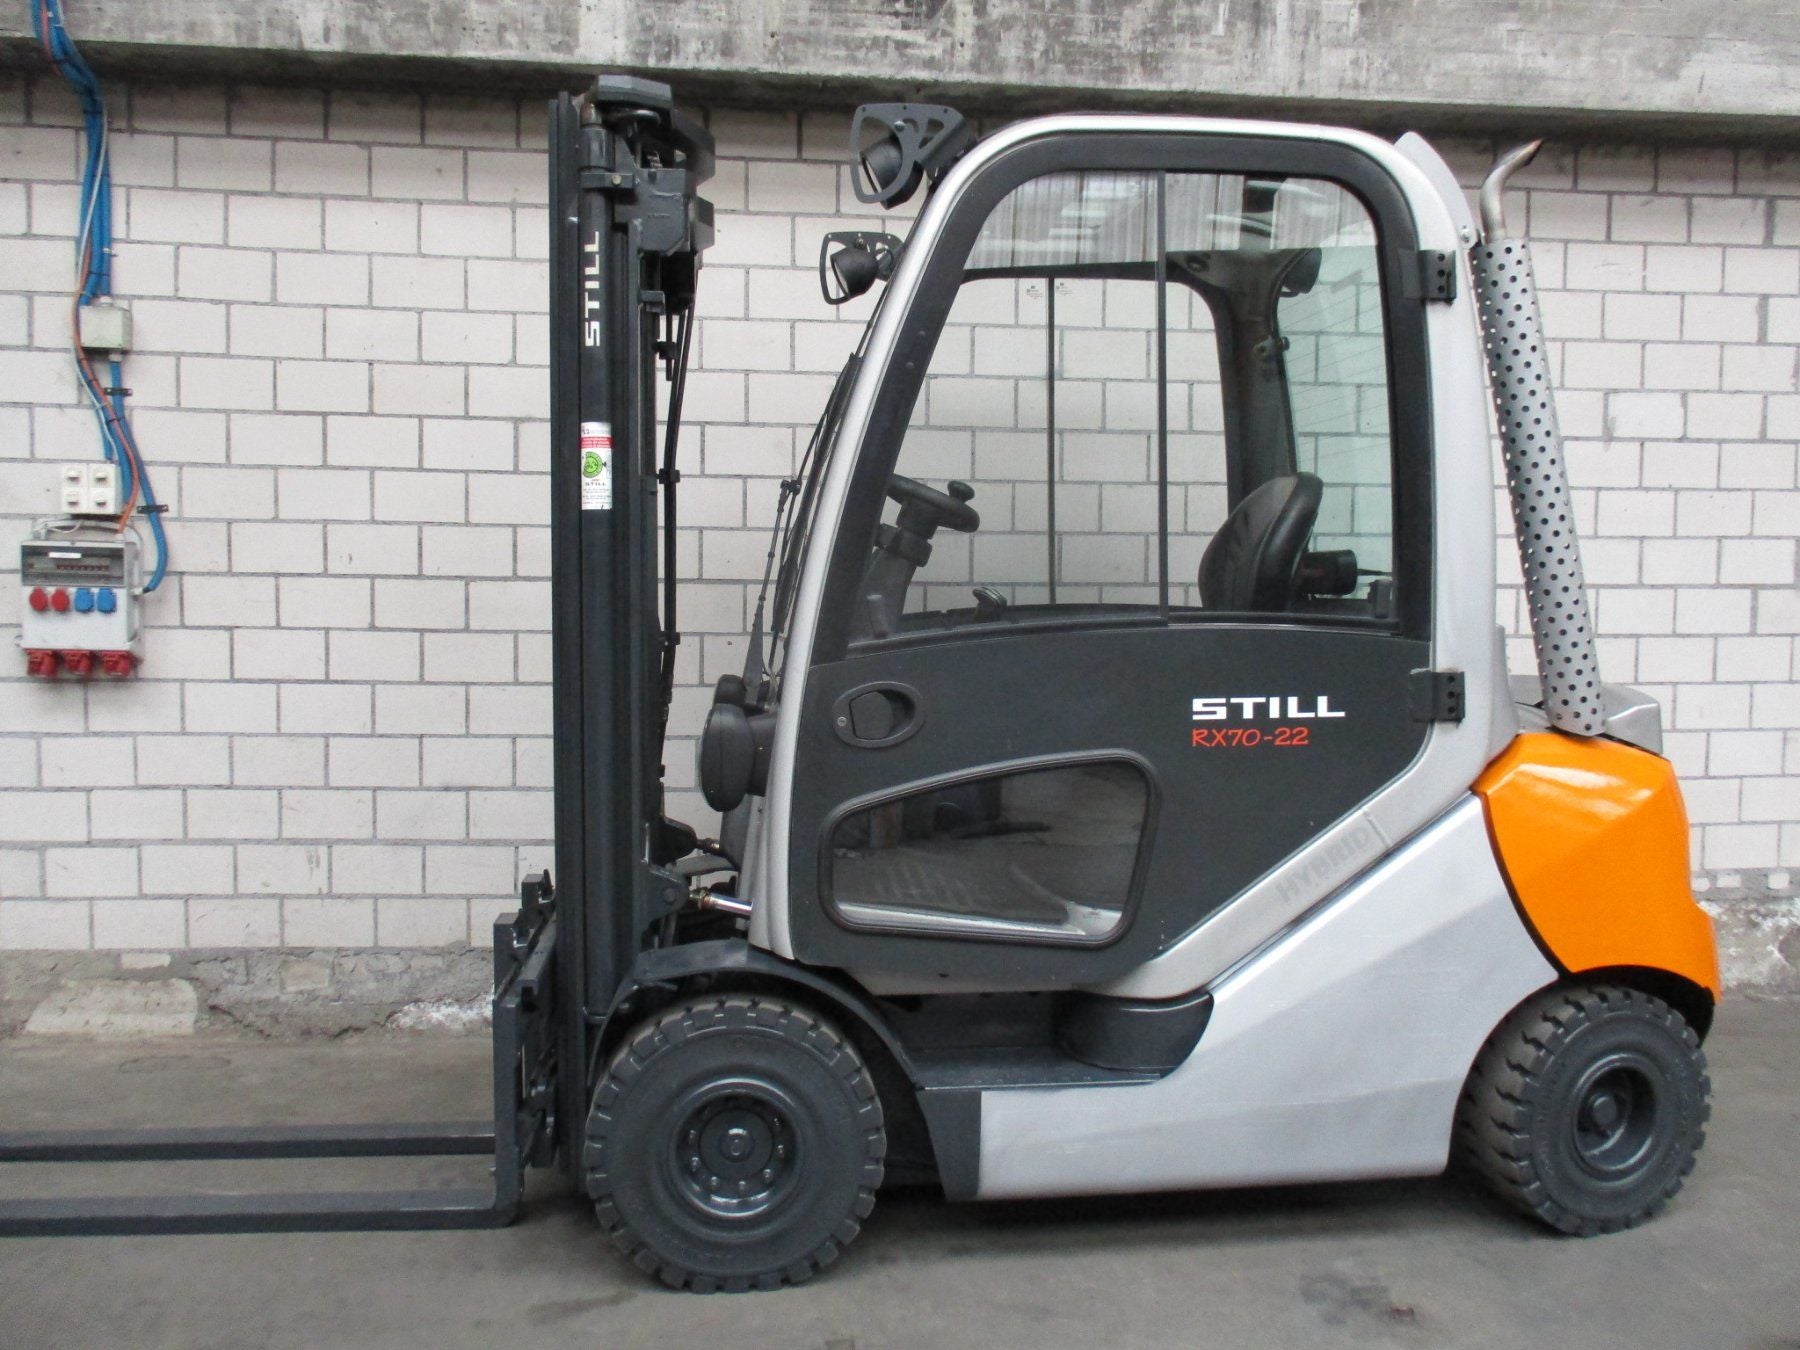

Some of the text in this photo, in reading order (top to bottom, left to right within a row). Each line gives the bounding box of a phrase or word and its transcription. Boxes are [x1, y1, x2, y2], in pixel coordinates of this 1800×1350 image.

[584, 231, 600, 347] STILL
[1192, 695, 1346, 721] STILL
[1191, 727, 1309, 747] RX70-22
[1275, 826, 1369, 903] HYBRID
